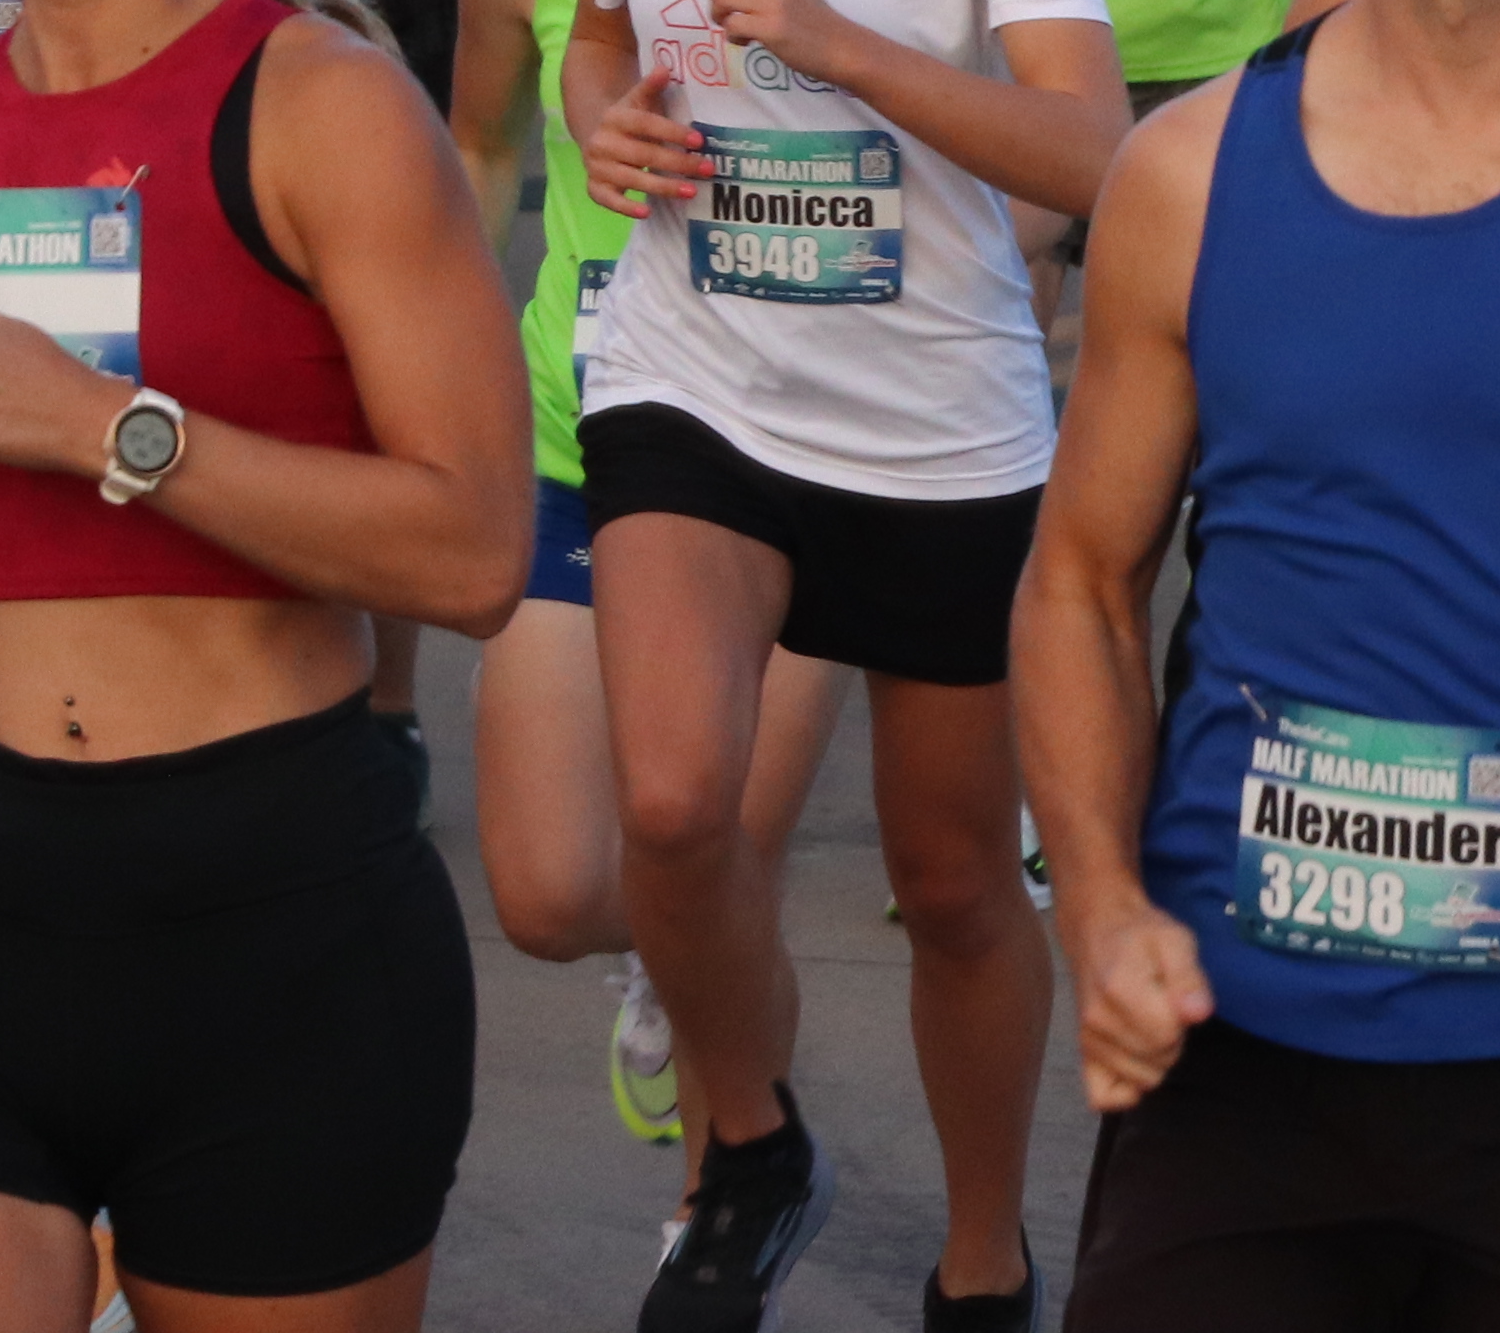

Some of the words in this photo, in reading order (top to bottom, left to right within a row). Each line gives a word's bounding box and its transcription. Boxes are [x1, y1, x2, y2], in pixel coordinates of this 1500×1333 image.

[740, 157, 855, 184] MARATHON
[712, 183, 875, 228] Monicca
[707, 229, 820, 283] 3948
[1251, 735, 1308, 778] HALF
[1309, 749, 1459, 803] MARATHON
[1257, 852, 1406, 938] 3298
